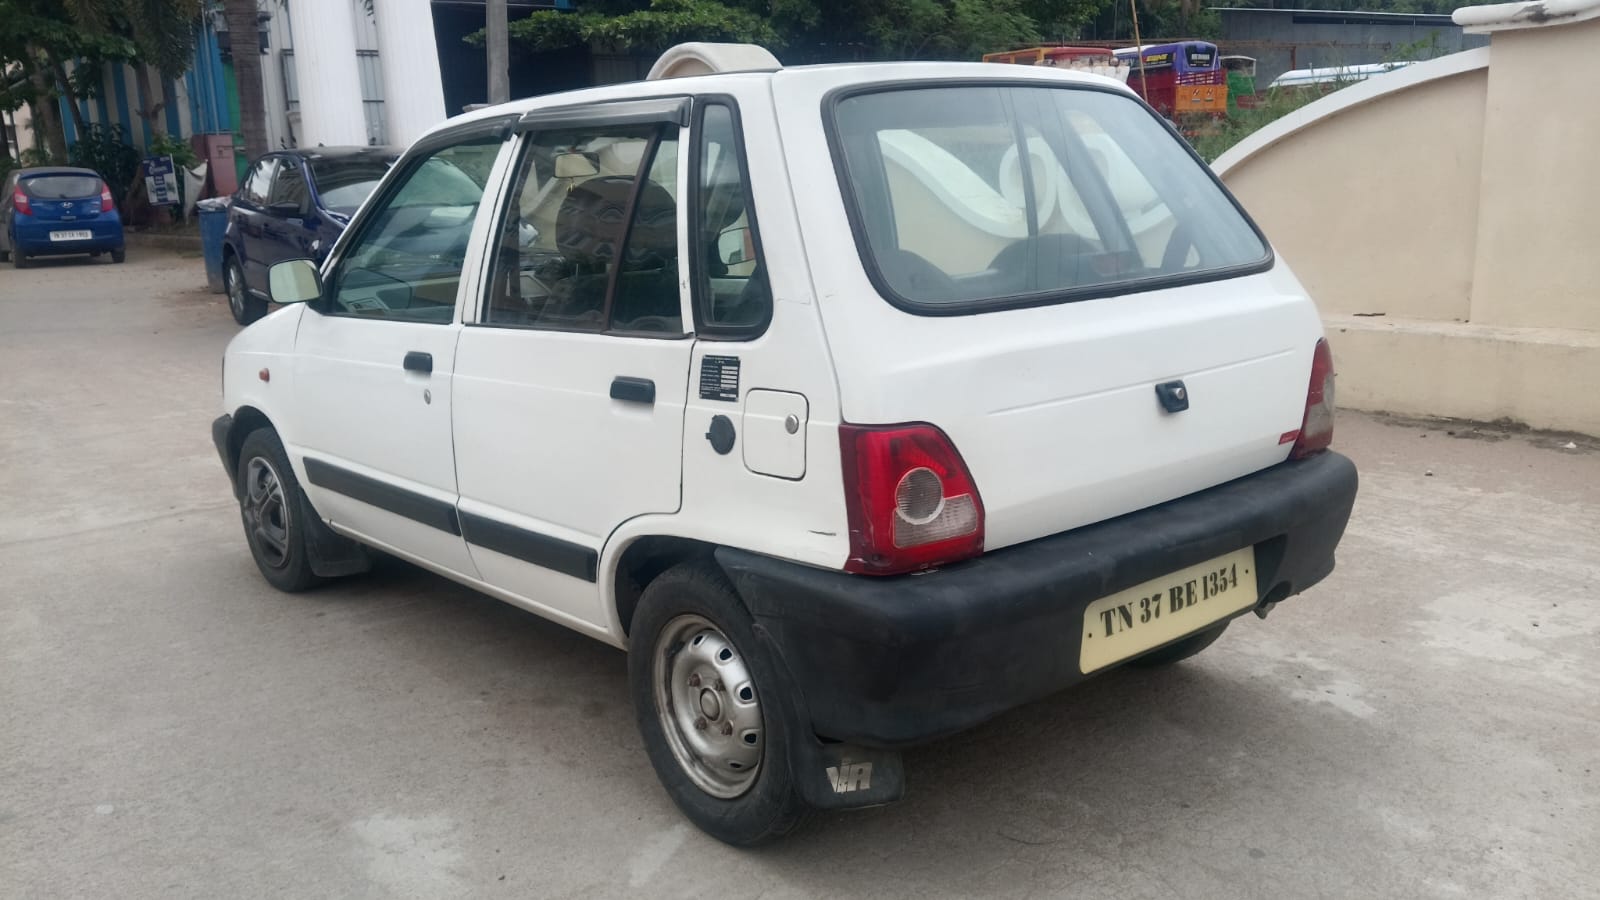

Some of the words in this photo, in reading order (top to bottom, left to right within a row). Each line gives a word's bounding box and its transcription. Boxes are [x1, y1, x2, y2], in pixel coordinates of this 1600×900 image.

[1100, 601, 1133, 638] TN
[1140, 593, 1162, 624] 37
[1169, 579, 1198, 613] BE
[1203, 563, 1238, 601] 1354
